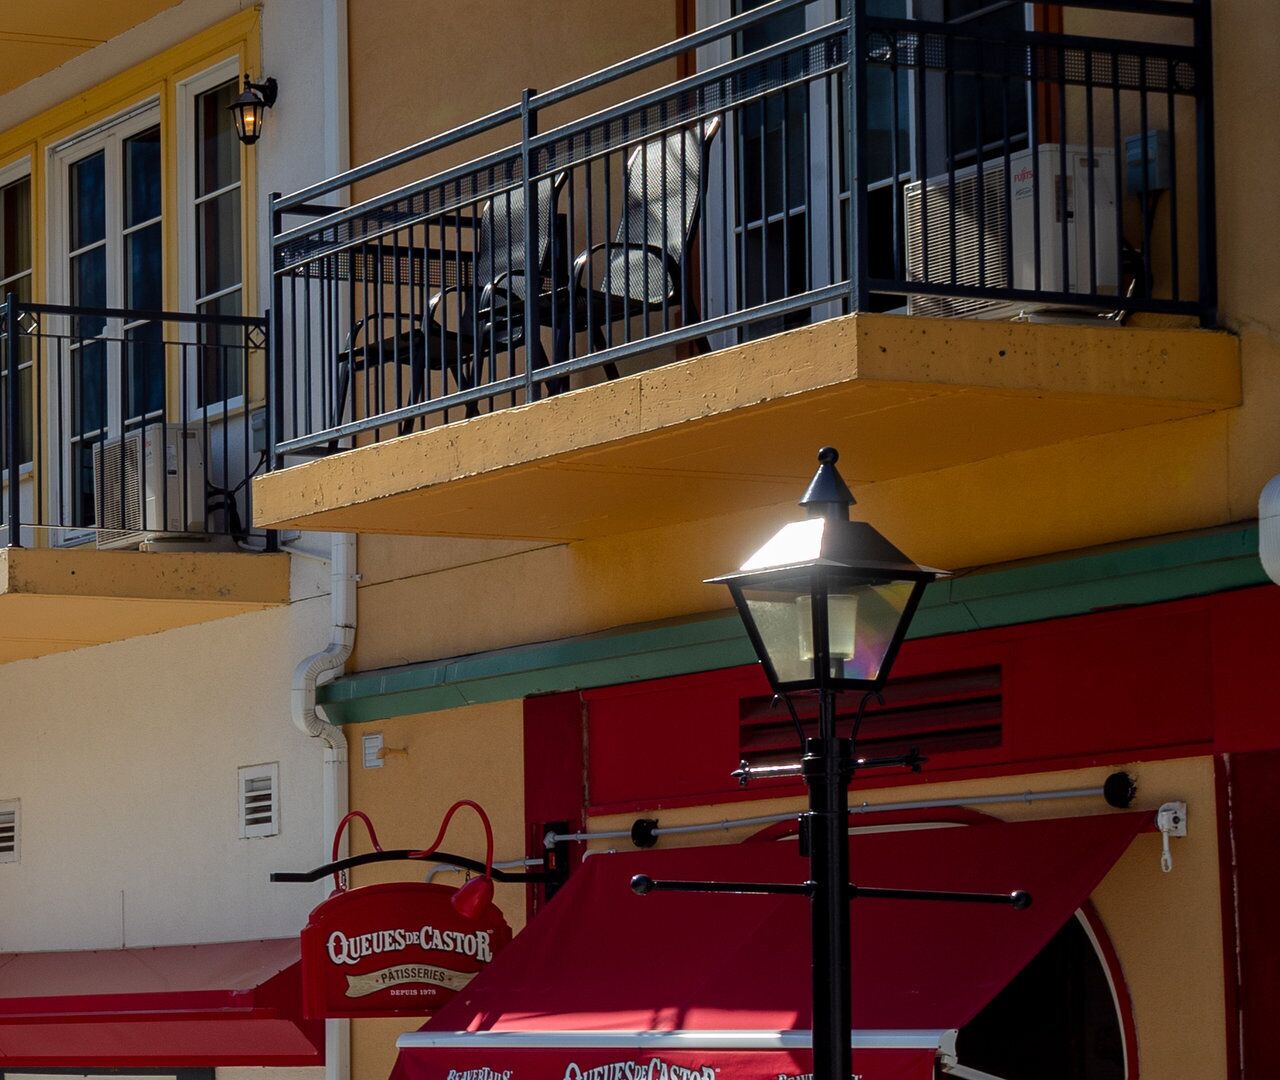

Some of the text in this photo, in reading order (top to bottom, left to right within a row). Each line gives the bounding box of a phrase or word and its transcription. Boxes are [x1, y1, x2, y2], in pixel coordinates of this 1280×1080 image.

[419, 925, 493, 963] CASTOR
[380, 967, 446, 983] PÂTISSERIES
[390, 988, 418, 996] DEPUIS
